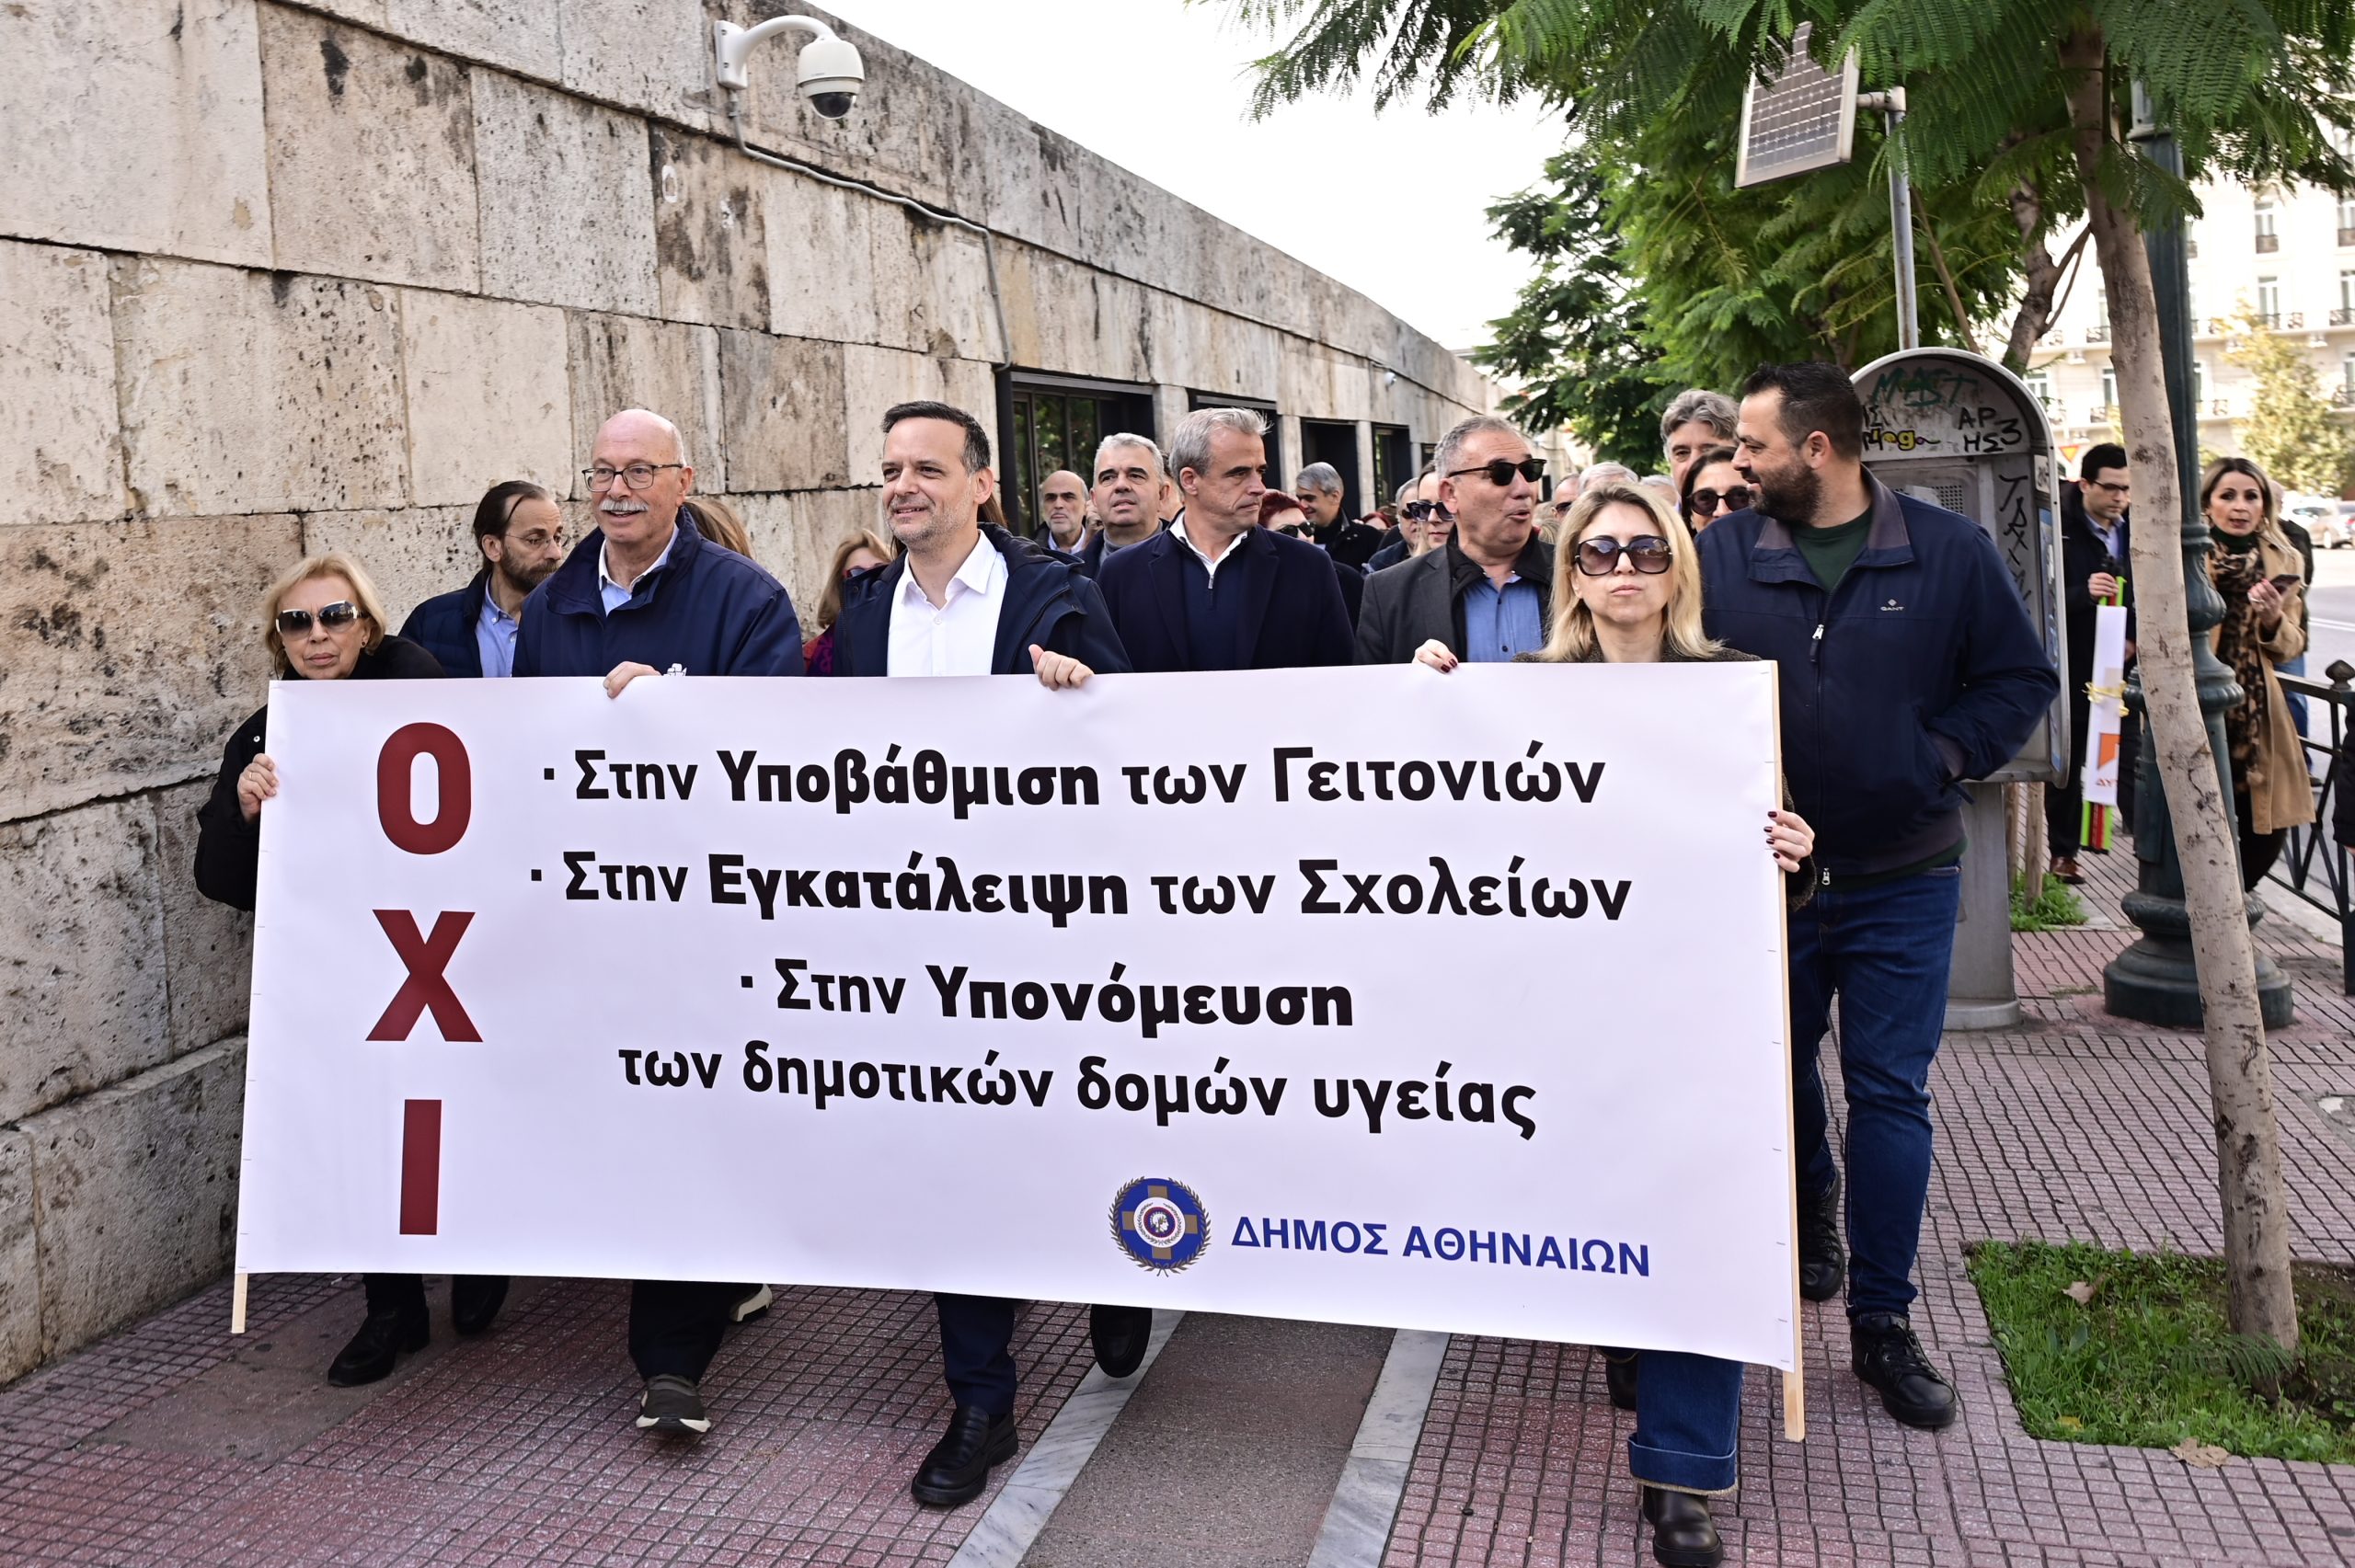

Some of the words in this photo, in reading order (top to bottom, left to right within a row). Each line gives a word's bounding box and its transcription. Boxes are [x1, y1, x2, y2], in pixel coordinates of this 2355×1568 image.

[575, 750, 698, 800] Στην
[717, 743, 1099, 819] Υποβάθμιση
[1122, 764, 1246, 805] των
[1273, 740, 1605, 803] Γειτονιών
[563, 852, 688, 902] Στην
[708, 851, 1128, 928] Εγκατάλειψη
[1151, 876, 1276, 914] των
[1299, 855, 1632, 920] Σχολείων
[775, 958, 906, 1013] Στην
[925, 962, 1352, 1038] Υπονόμευση
[618, 1049, 722, 1089] των
[743, 1040, 1053, 1110] δημοτικών
[1077, 1056, 1287, 1127] δομών
[1314, 1060, 1536, 1140] υγείας
[1232, 1217, 1388, 1256] ΔΗΜΟΣ
[1403, 1226, 1649, 1276] ΑΘΗΝΑΙΩΝ
